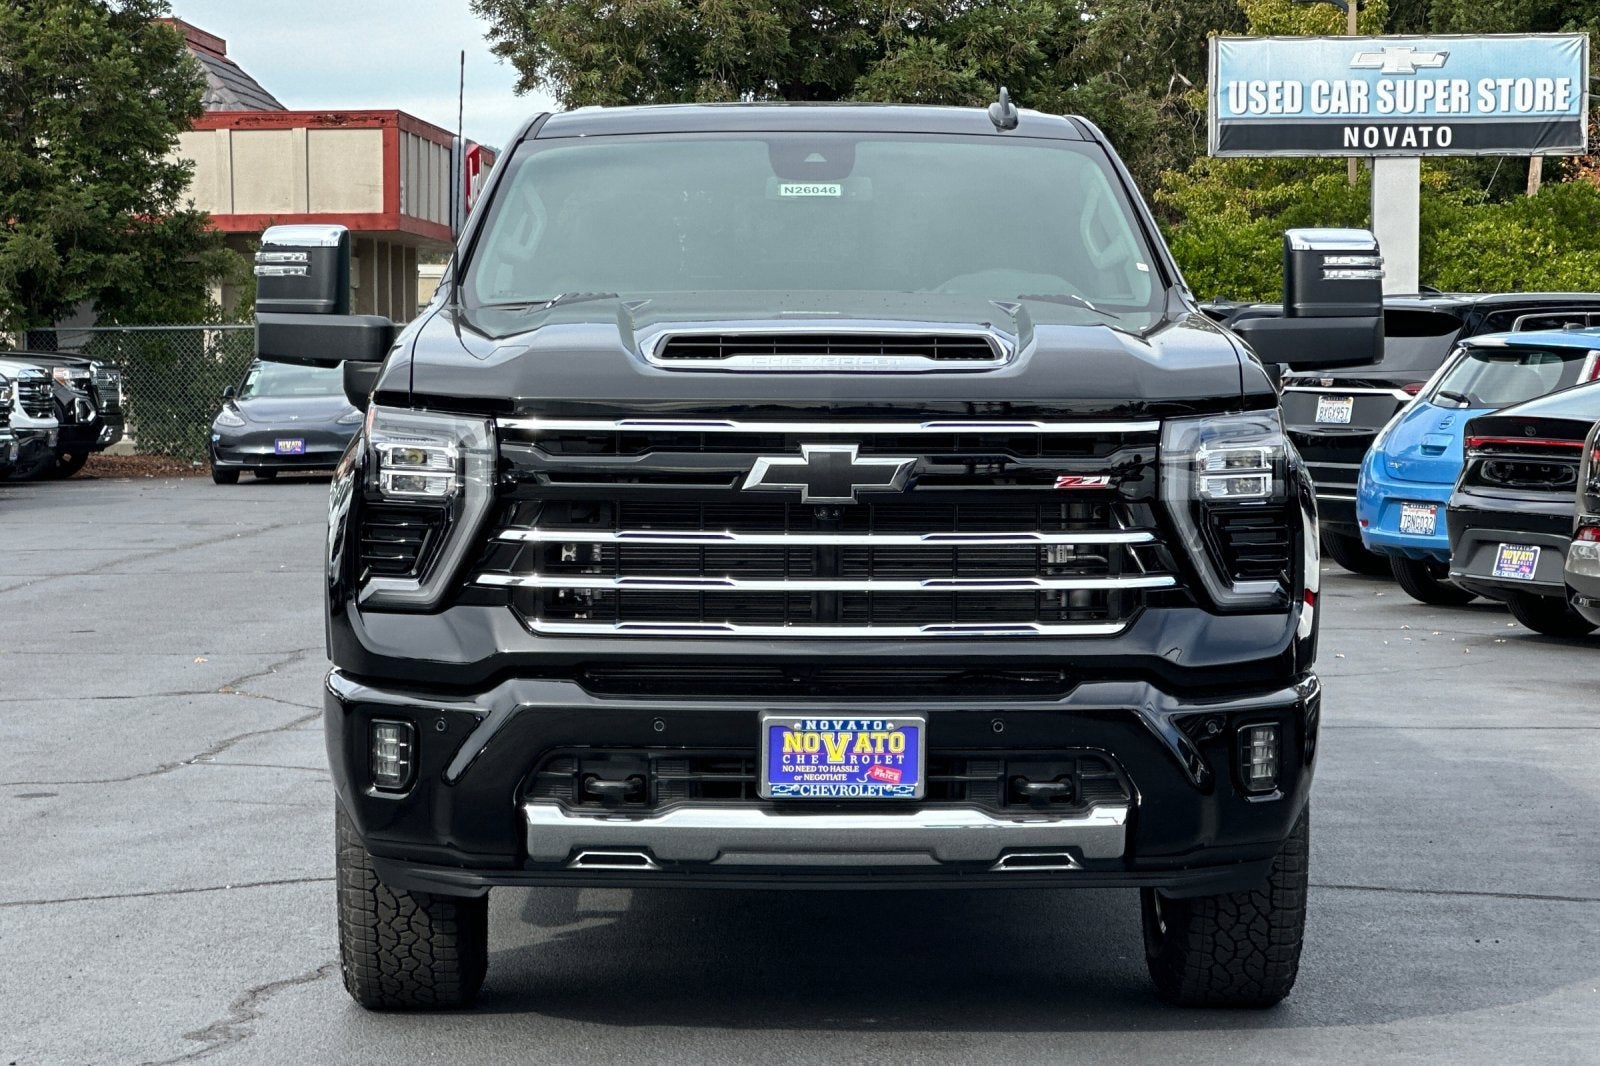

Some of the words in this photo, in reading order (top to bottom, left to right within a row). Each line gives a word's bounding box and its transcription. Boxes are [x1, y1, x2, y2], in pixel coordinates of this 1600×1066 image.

[1229, 79, 1303, 114] USED
[1311, 79, 1368, 114] CAR
[1376, 78, 1470, 114] SUPER
[1477, 77, 1572, 113] STORE
[1343, 125, 1452, 148] NOVATO
[784, 186, 837, 194] N26046
[806, 720, 883, 730] NOVATO
[782, 731, 906, 764] NOVATO
[782, 765, 795, 773] NO
[795, 765, 817, 773] NEED
[818, 765, 829, 773] TO
[829, 765, 860, 773] HASSLE
[800, 784, 887, 796] CHEVROLET
